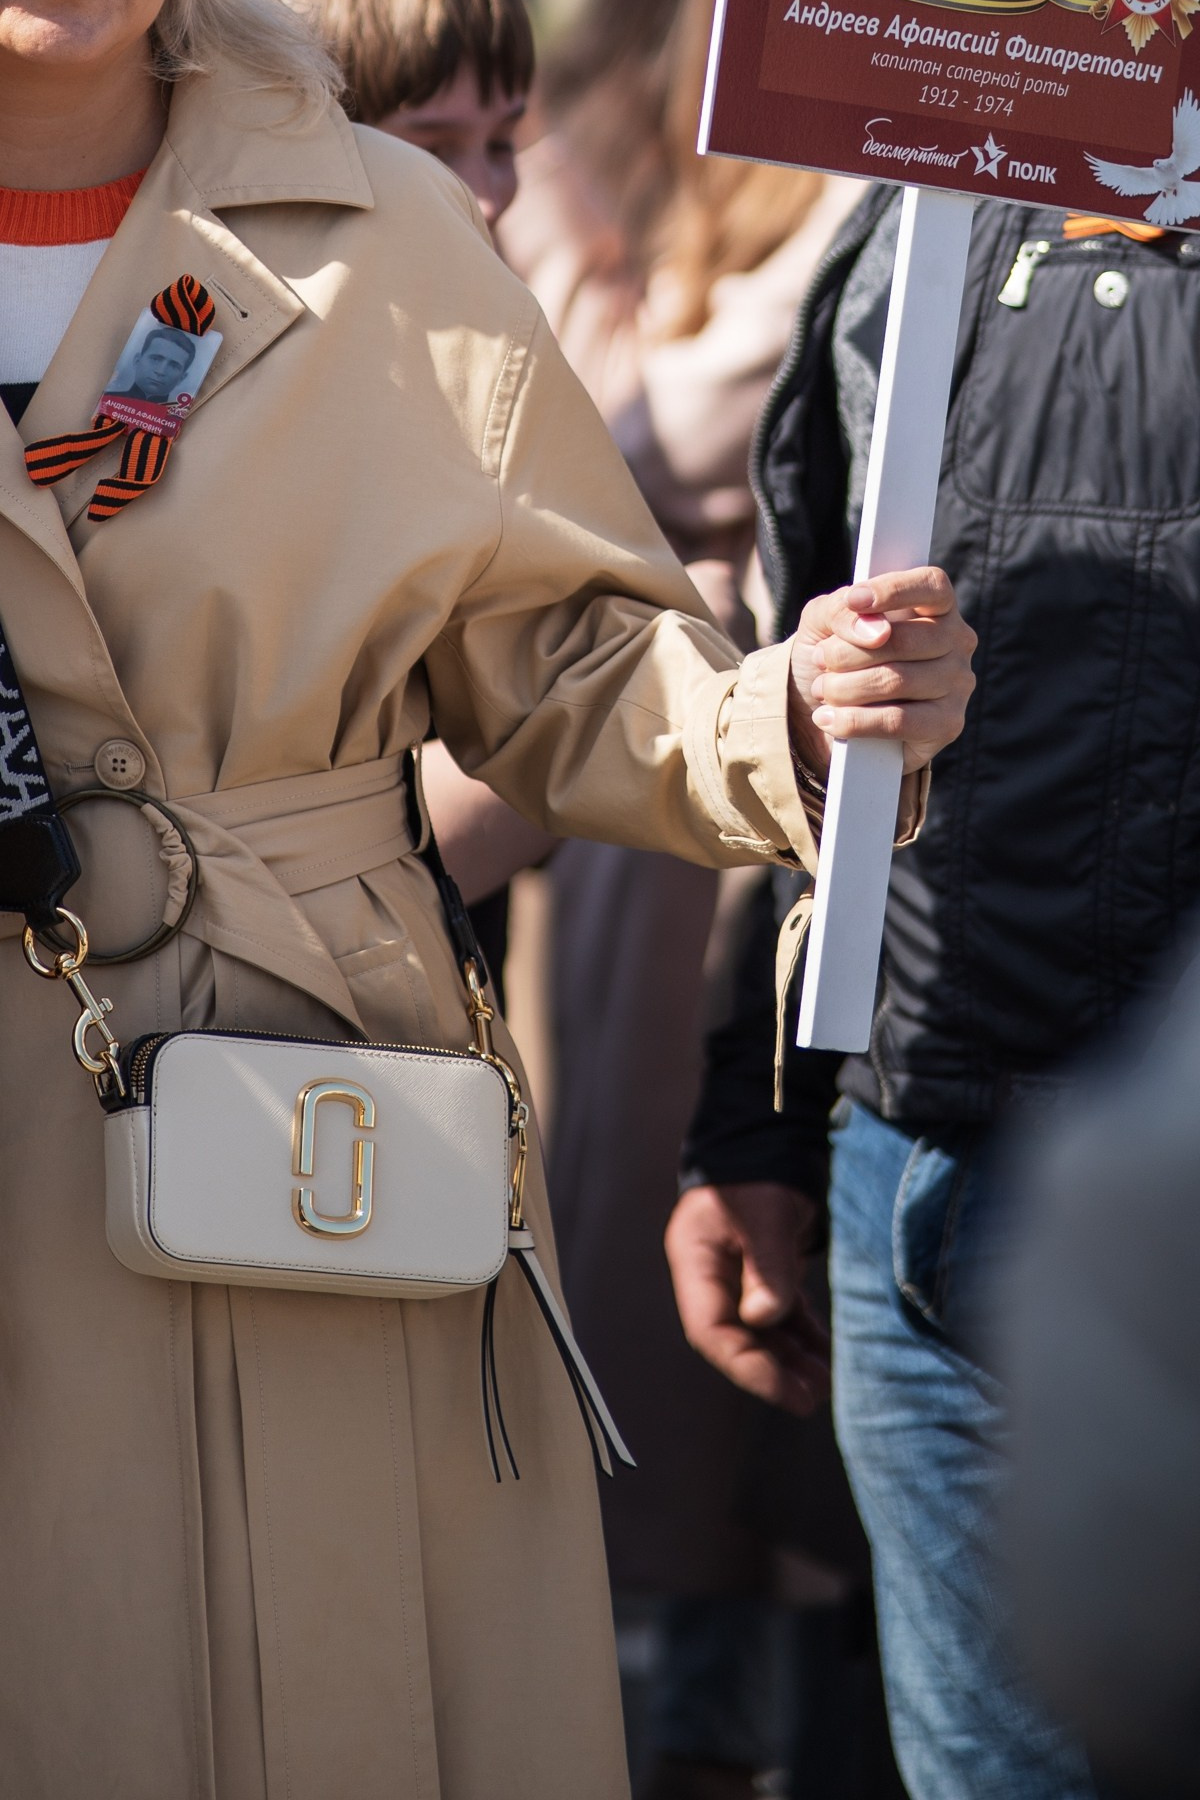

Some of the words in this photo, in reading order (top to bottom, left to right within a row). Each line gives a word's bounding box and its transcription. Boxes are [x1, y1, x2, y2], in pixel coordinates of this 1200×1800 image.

[883, 14, 1000, 57] Афанасий
[1005, 34, 1163, 84] Филаретович
[870, 52, 942, 76] капитан
[946, 64, 1021, 89] саперной
[1022, 77, 1069, 97] роты
[918, 85, 960, 108] 1912
[973, 93, 1014, 117] 1974
[105, 400, 136, 414] АНДРЕЕВ
[136, 411, 176, 429] АФАНАСИЙ
[111, 411, 163, 434] ФИЛАРЕТОВИЧ
